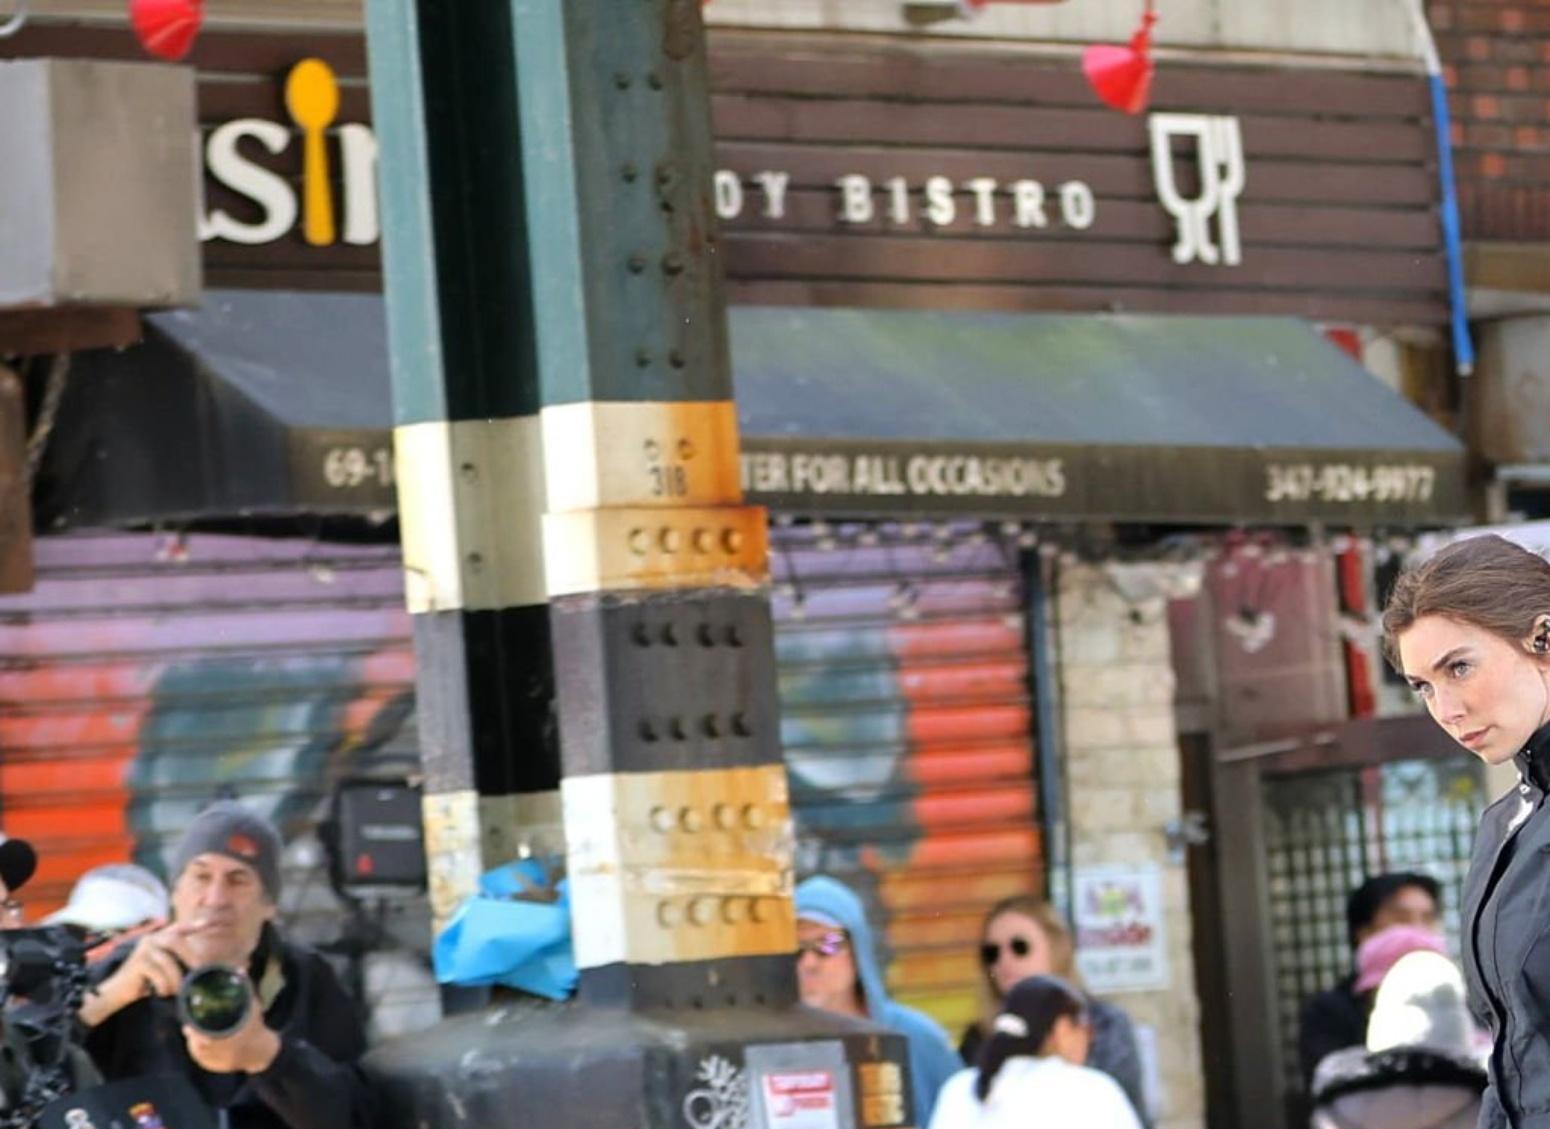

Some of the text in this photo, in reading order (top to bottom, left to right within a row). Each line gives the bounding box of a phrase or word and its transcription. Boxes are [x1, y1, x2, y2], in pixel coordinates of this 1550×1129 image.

[836, 173, 1096, 230] BISTRO
[791, 453, 848, 494] FOR
[853, 454, 906, 496] ALL
[907, 455, 1065, 498] OCCASIONS
